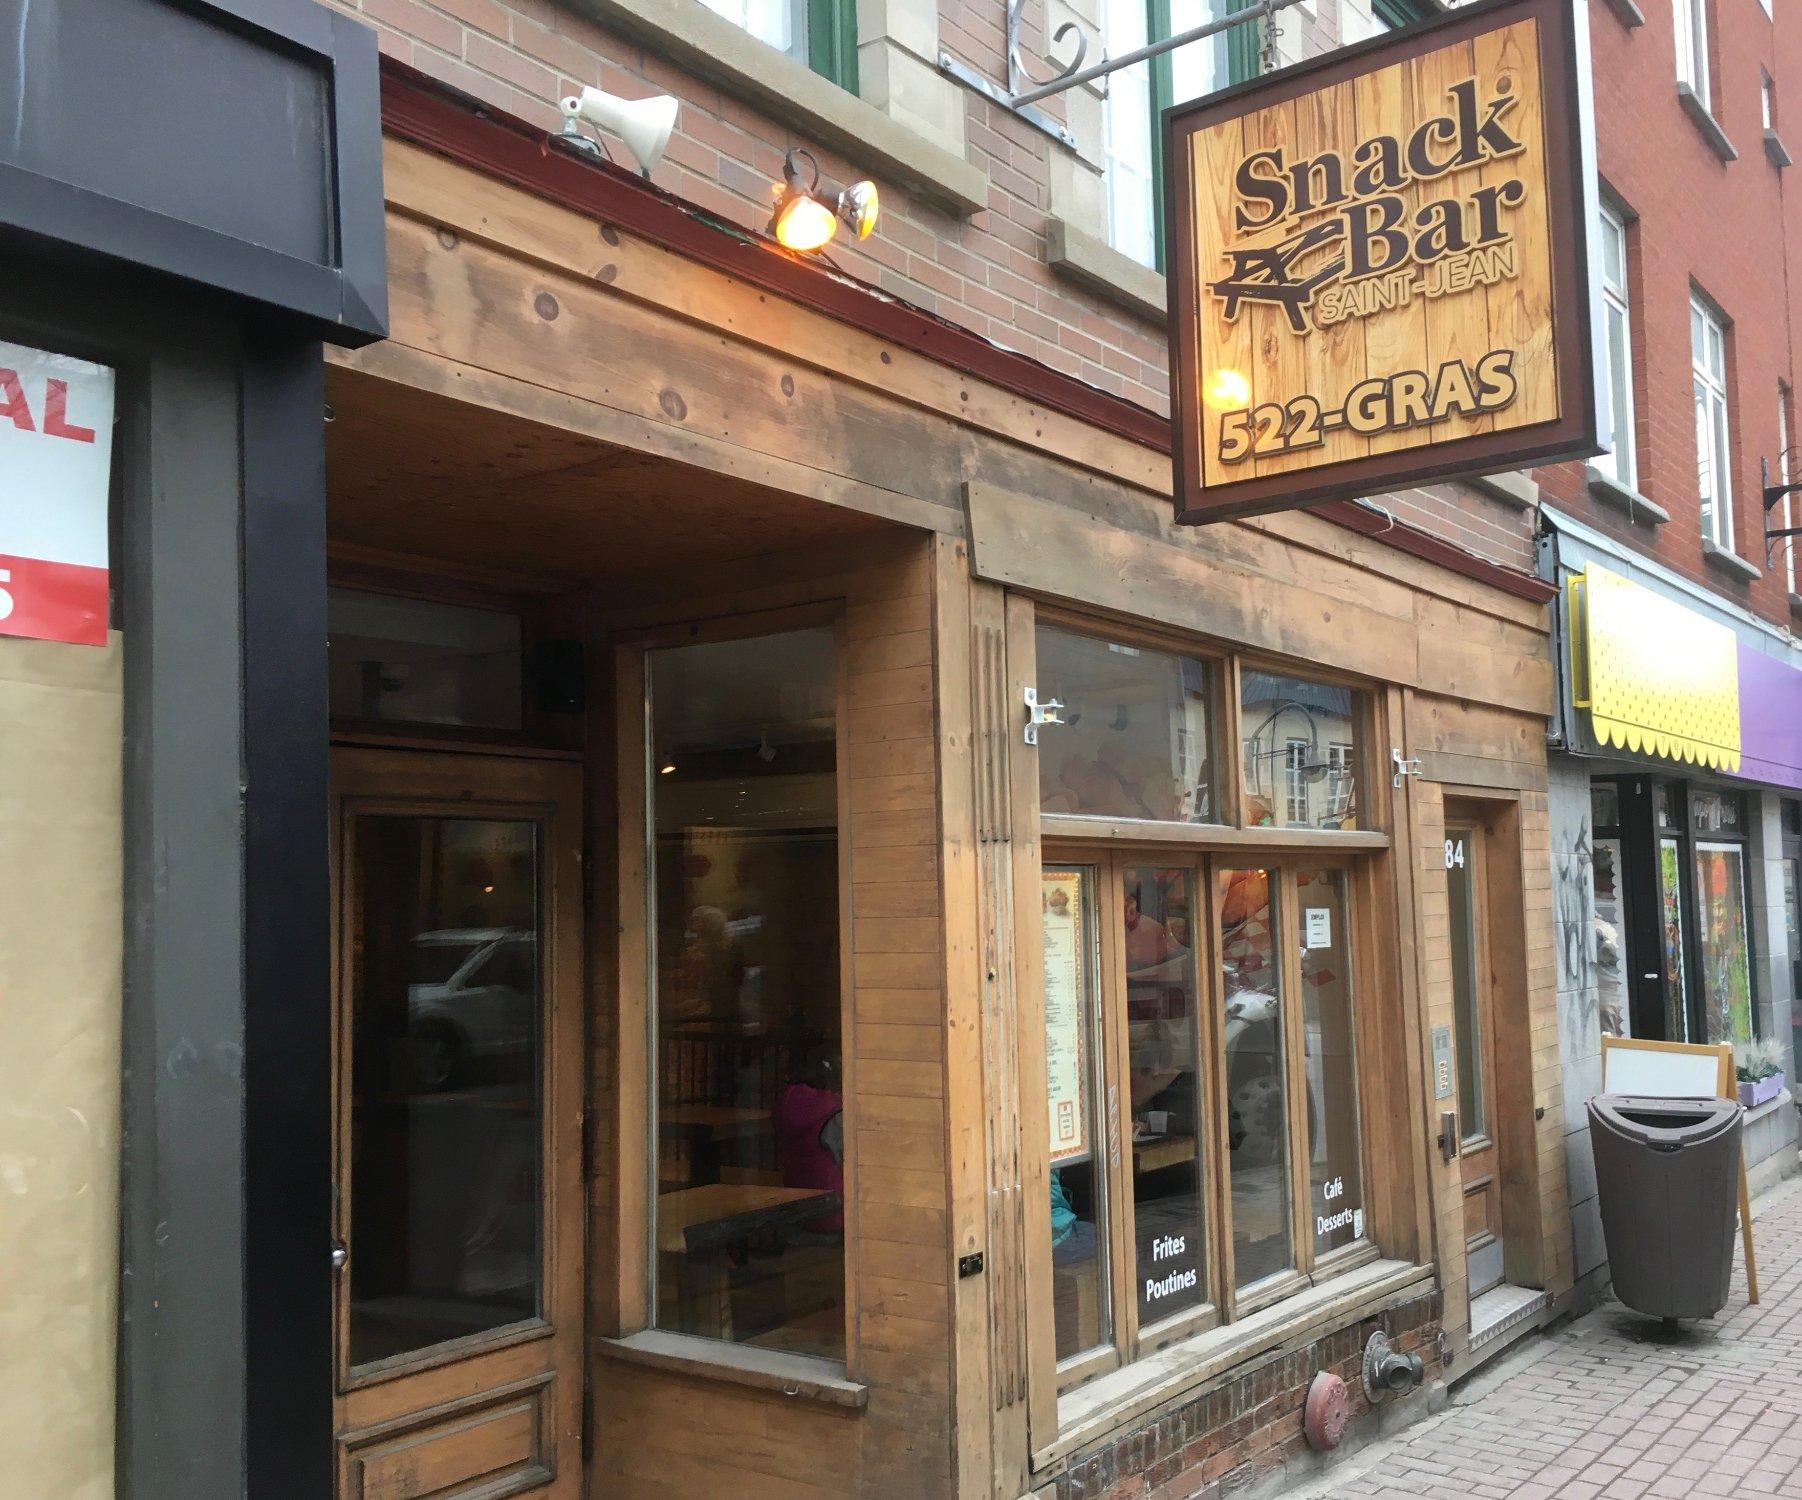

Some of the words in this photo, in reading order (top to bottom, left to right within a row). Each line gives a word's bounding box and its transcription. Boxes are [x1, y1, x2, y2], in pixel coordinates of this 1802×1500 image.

[1234, 76, 1527, 233] Snack
[1342, 176, 1526, 283] Bar
[1317, 243, 1519, 324] SAINT-JEAN
[1217, 349, 1518, 464] 522-GRAS
[1445, 839, 1464, 868] 84
[1324, 1176, 1343, 1200] Café
[1317, 1207, 1353, 1235] Desserts
[1153, 1235, 1185, 1261] Frites
[1146, 1269, 1197, 1302] Poutines
